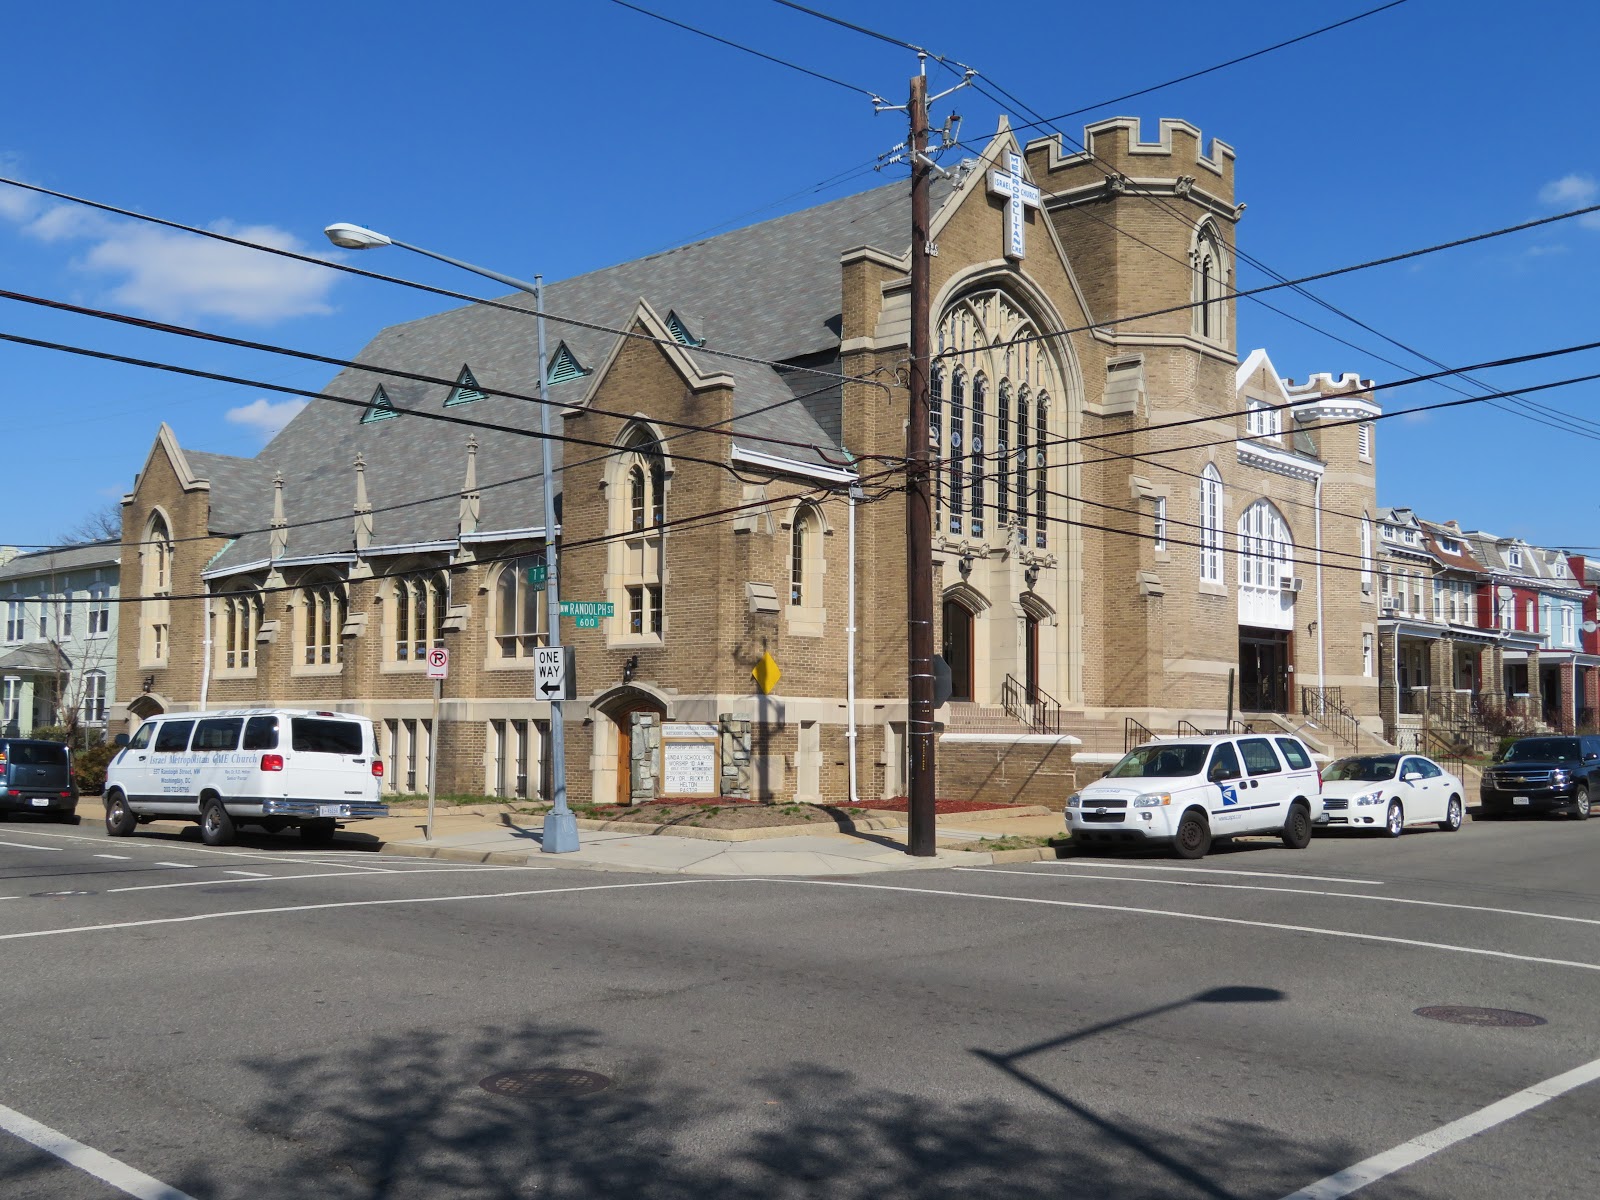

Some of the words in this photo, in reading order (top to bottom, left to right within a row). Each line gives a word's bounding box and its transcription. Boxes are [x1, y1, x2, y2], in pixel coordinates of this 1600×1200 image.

[994, 178, 1012, 190] ISRAEL
[1020, 188, 1039, 200] CHURCH
[1010, 156, 1021, 246] METROPOLITAN
[561, 605, 569, 613] NW
[569, 603, 607, 615] RANDOLPH
[606, 605, 614, 614] ST
[579, 618, 595, 627] 600
[539, 652, 559, 664] ONE
[539, 666, 560, 678] WAY
[149, 755, 168, 764] Israel
[169, 754, 210, 766] Metropolitan
[231, 753, 258, 764] Church
